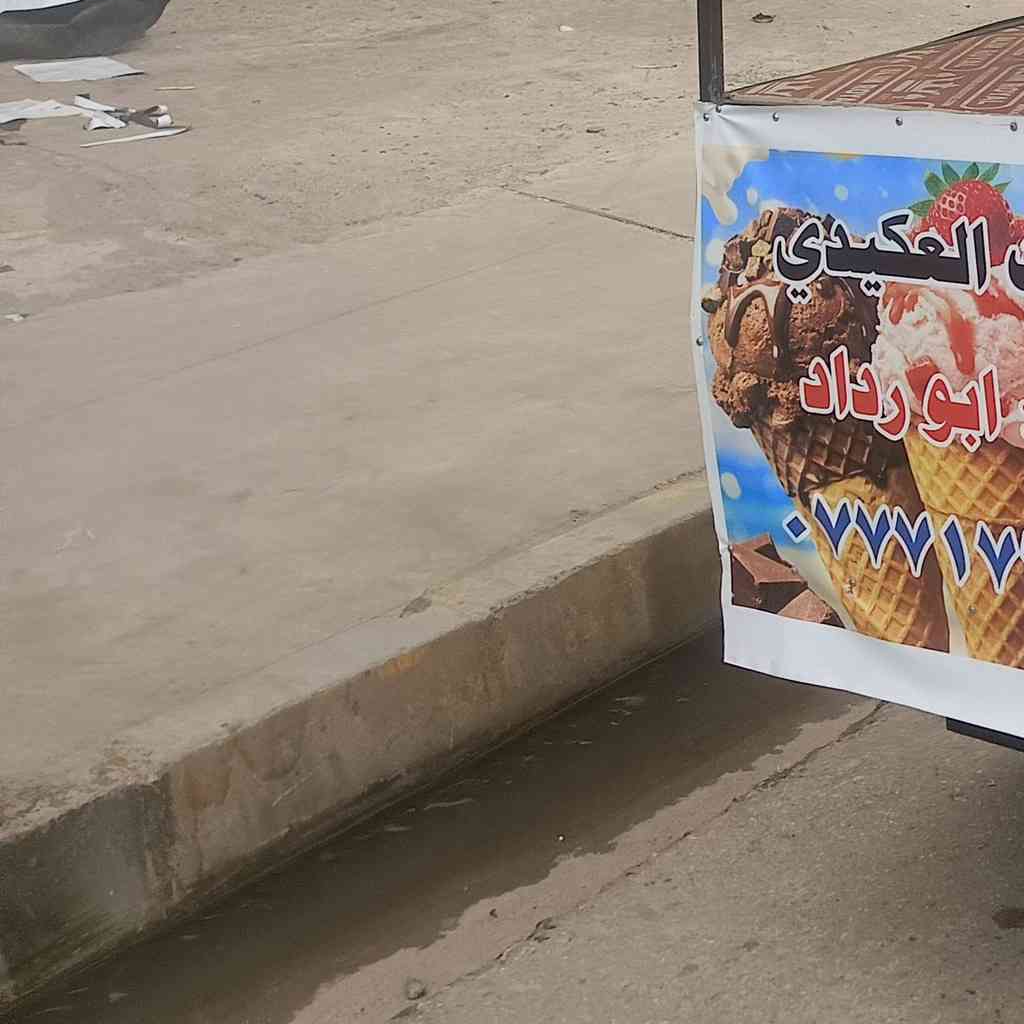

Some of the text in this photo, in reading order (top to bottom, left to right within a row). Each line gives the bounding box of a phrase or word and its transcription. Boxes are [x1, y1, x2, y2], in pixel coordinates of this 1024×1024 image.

[775, 213, 990, 300] العكيدي
[802, 347, 909, 438] رداد
[920, 367, 1000, 450] ابو
